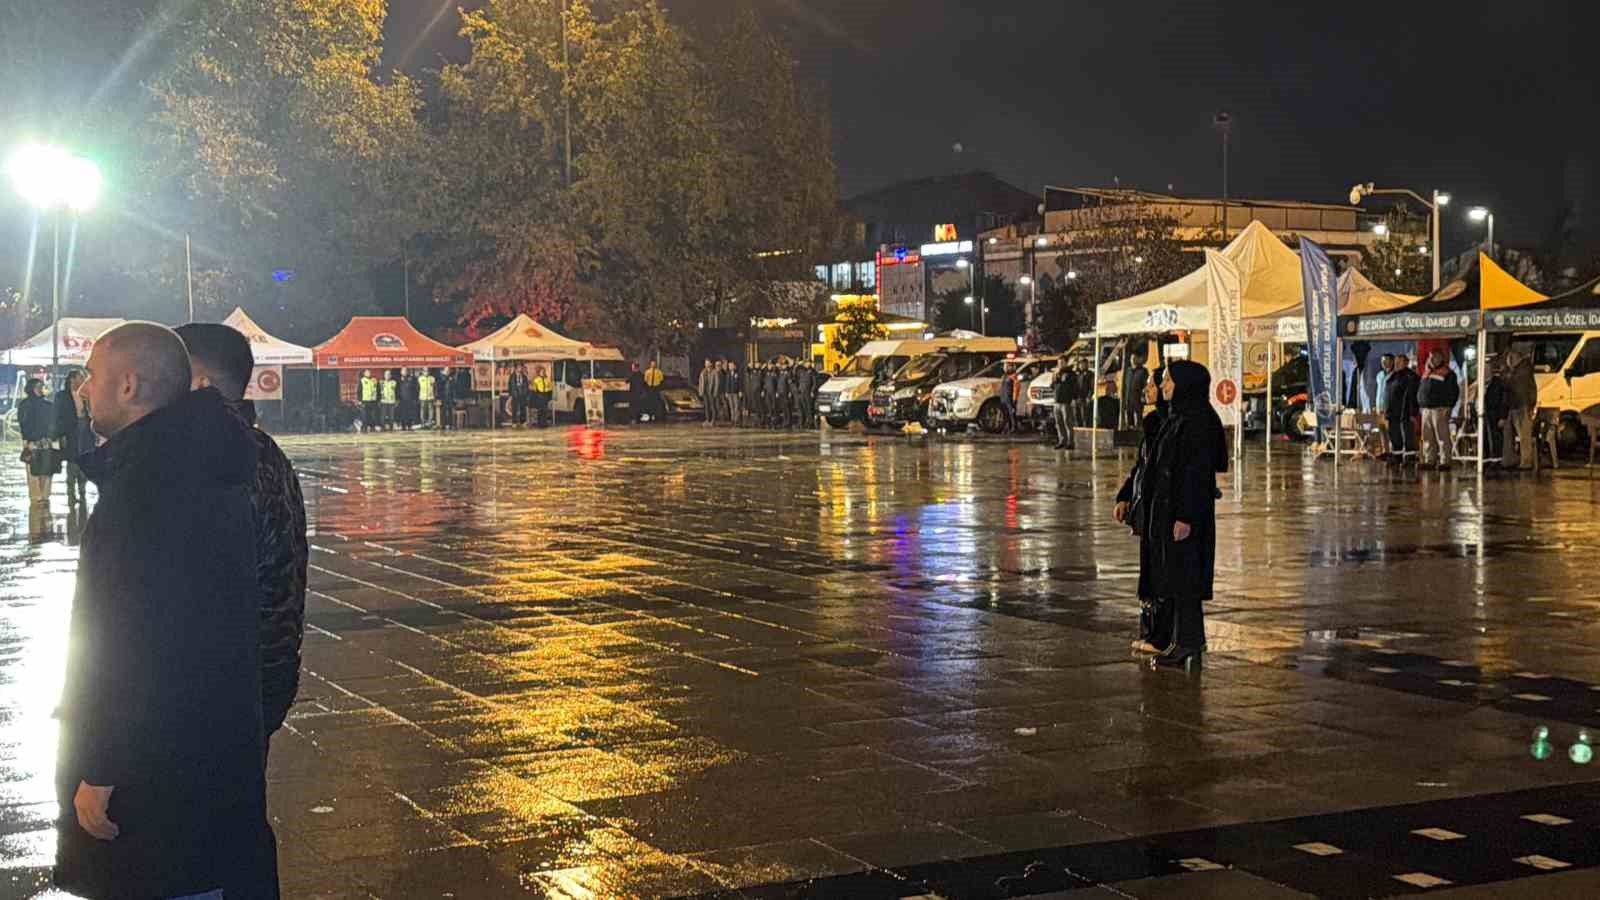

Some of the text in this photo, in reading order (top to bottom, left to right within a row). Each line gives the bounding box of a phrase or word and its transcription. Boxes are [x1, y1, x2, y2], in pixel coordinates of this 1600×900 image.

[1405, 315, 1425, 329] ÖZEL
[1425, 315, 1457, 328] İDARESİ
[1554, 313, 1563, 326] İL
[1564, 312, 1587, 326] ÖZEL
